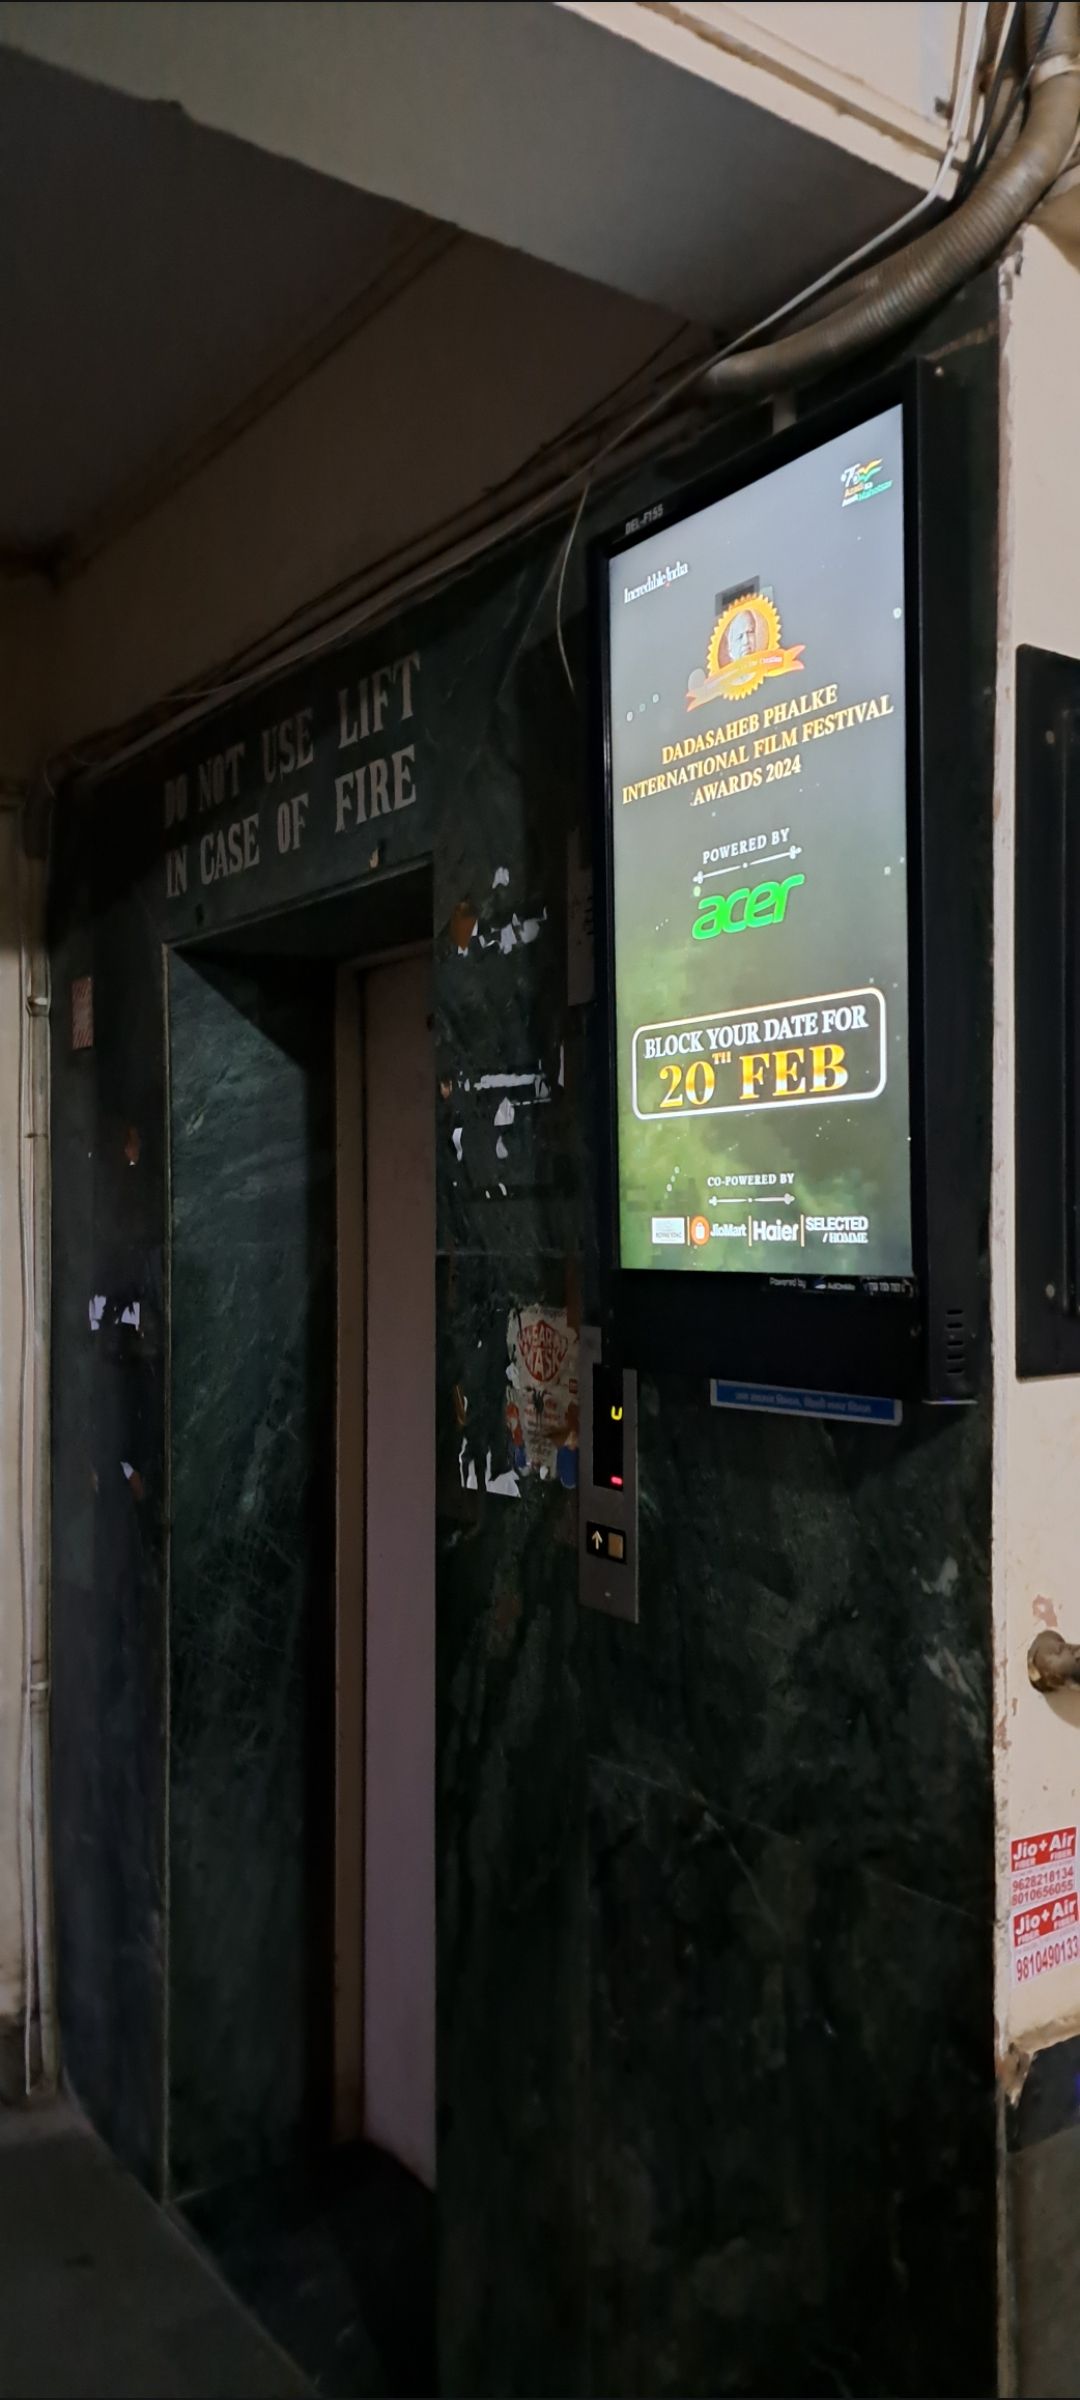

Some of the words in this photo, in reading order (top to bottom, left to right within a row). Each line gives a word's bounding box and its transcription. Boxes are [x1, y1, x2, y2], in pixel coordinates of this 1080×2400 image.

[164, 773, 188, 829] DO
[198, 742, 245, 812] NOT
[262, 707, 314, 783] USE
[337, 651, 421, 750] LIFT
[622, 745, 750, 805] INTERNATIONAL
[753, 729, 799, 759] FILM
[802, 694, 894, 743] FESTIVAL
[661, 714, 760, 765] DADASAHEB
[762, 683, 838, 730] PHALKE
[692, 769, 762, 807] AWARDS
[766, 754, 802, 782] 2024
[166, 844, 188, 898] IN
[200, 813, 260, 885] CASE
[277, 793, 309, 854] OF
[334, 745, 417, 833] FIRE
[703, 834, 767, 864] POWERED
[771, 827, 790, 845] BY
[691, 873, 805, 940] acer
[644, 1030, 704, 1059] BLOCK
[706, 1022, 761, 1051] YOUR
[763, 1012, 818, 1042] DATE
[822, 1004, 869, 1033] FOR
[739, 1043, 849, 1100] FEB
[707, 1174, 777, 1188] CO-POWERED
[779, 1173, 795, 1185] BY
[753, 1219, 799, 1242] Haier
[805, 1215, 869, 1232] SELECTED
